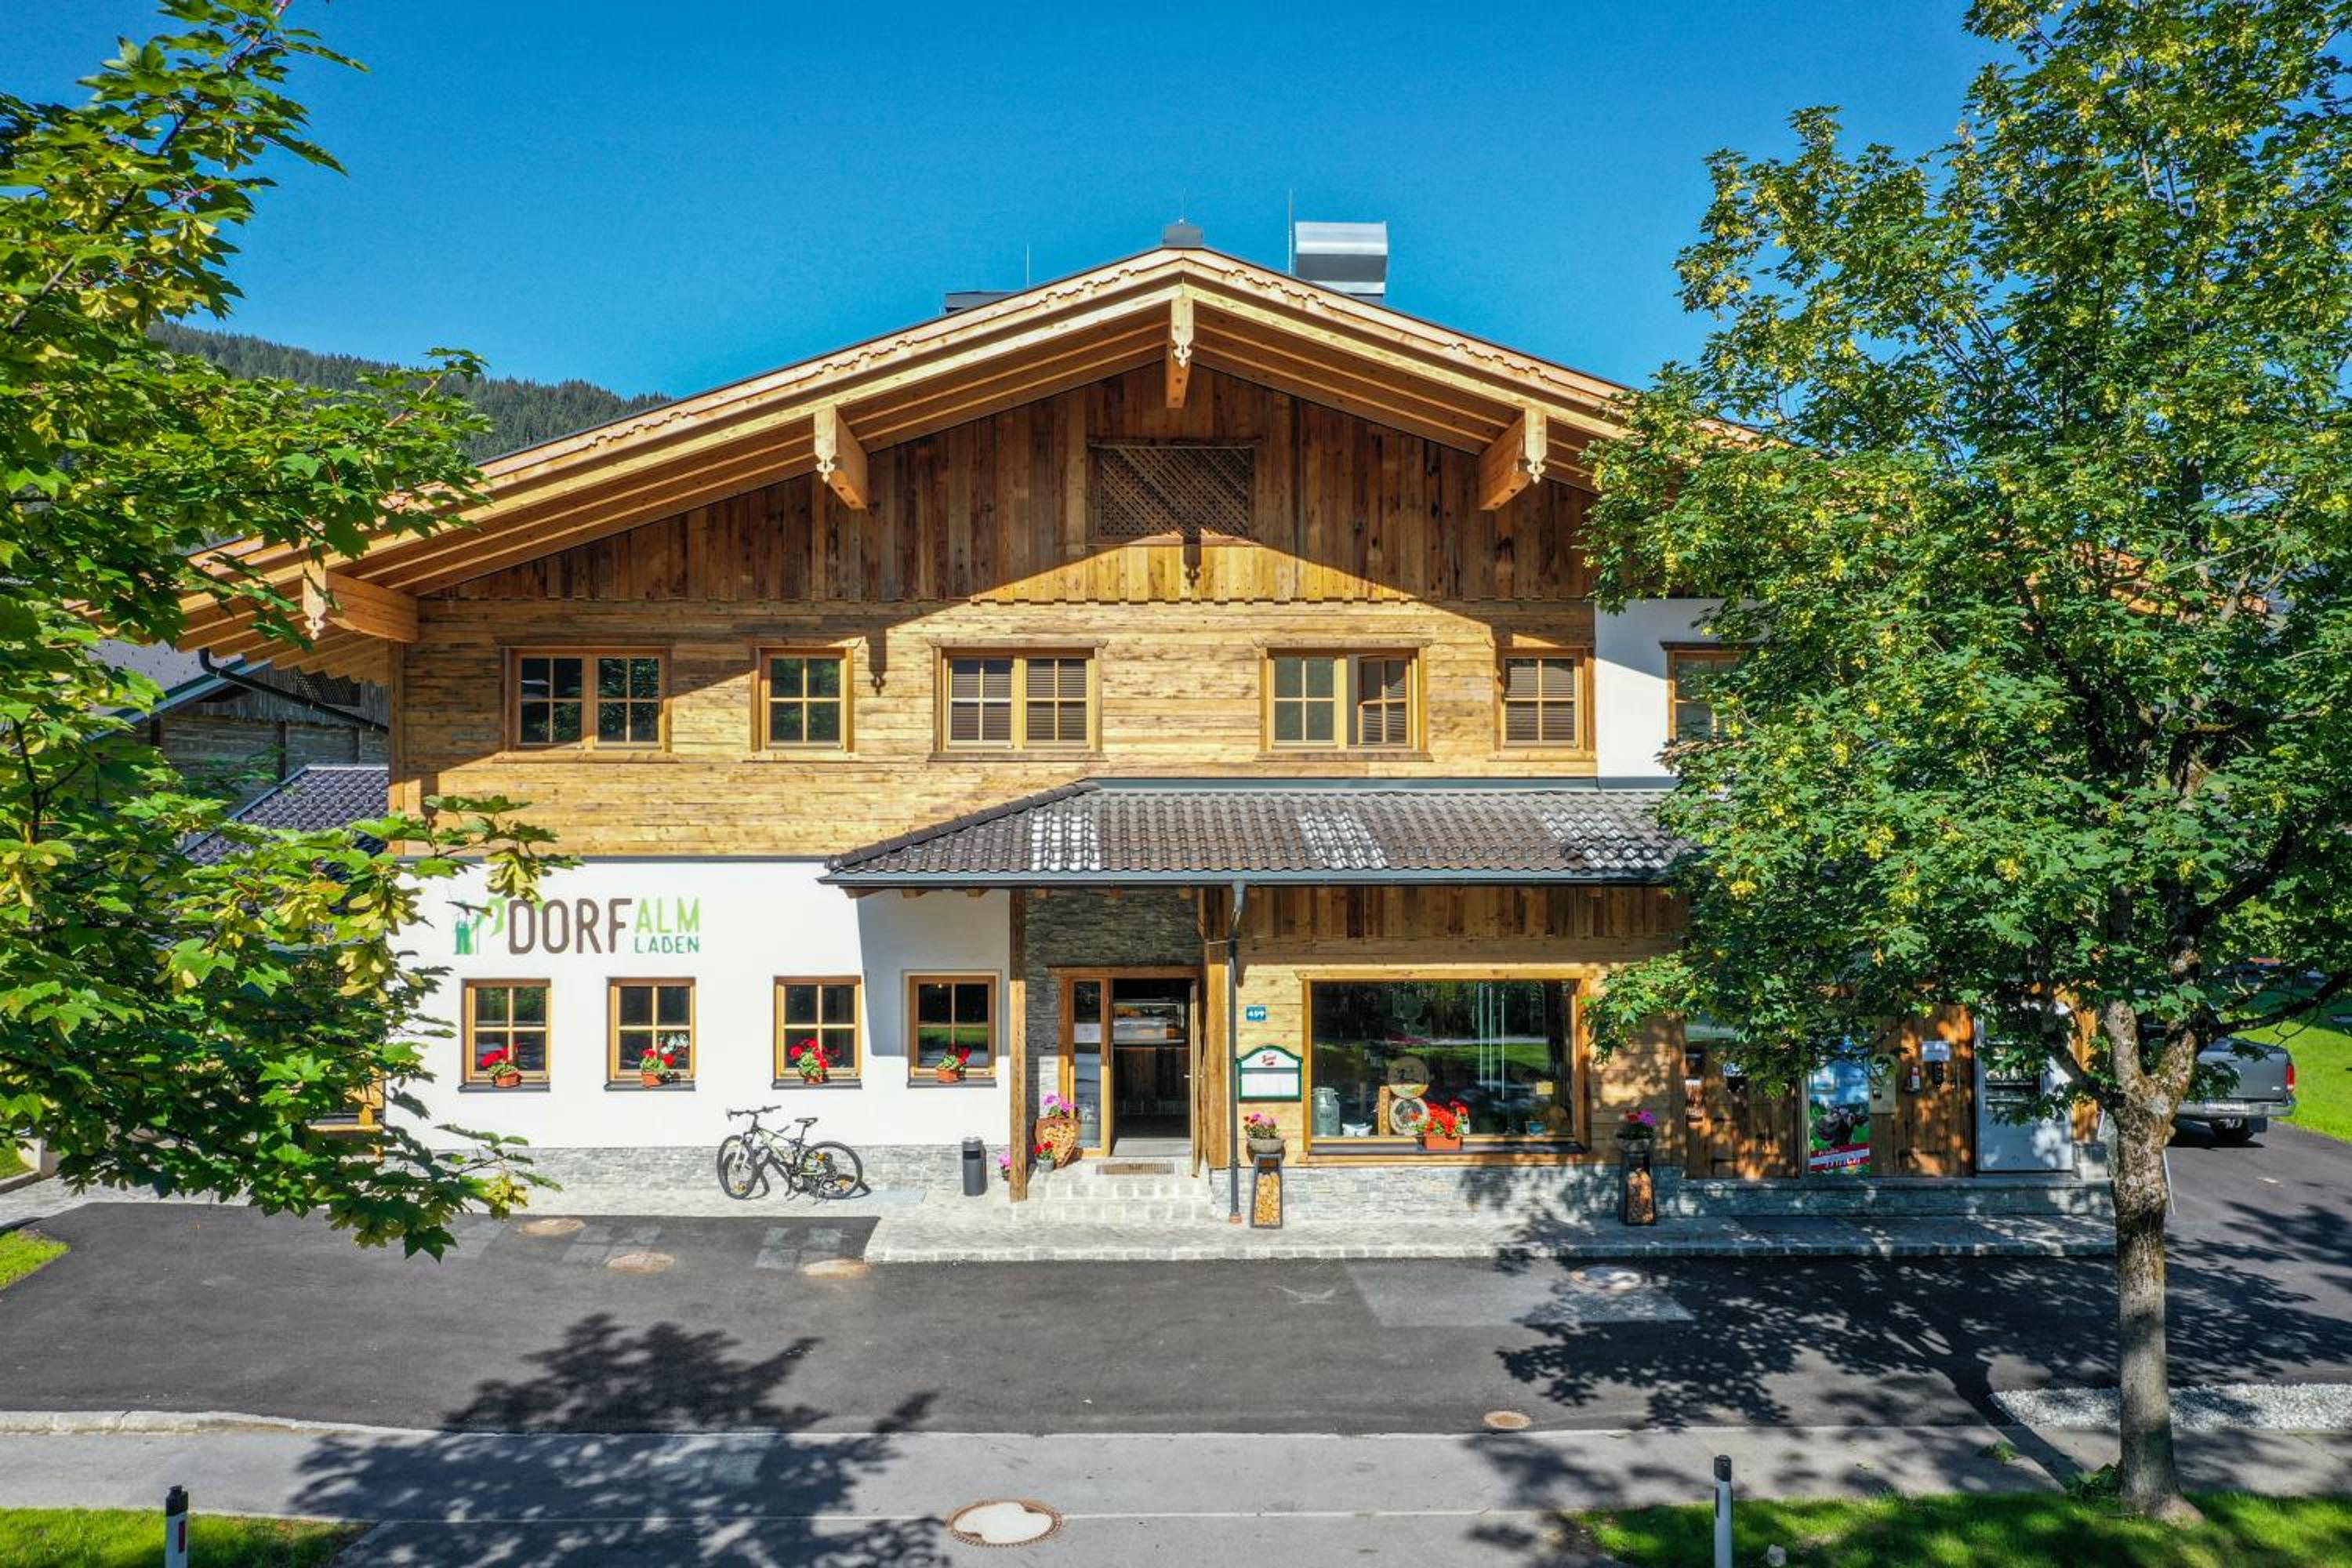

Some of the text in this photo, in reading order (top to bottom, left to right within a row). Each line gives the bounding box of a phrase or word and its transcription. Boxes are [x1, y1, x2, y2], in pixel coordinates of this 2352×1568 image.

[509, 897, 700, 955] DORF ALM
[634, 935, 700, 954] LADEN
